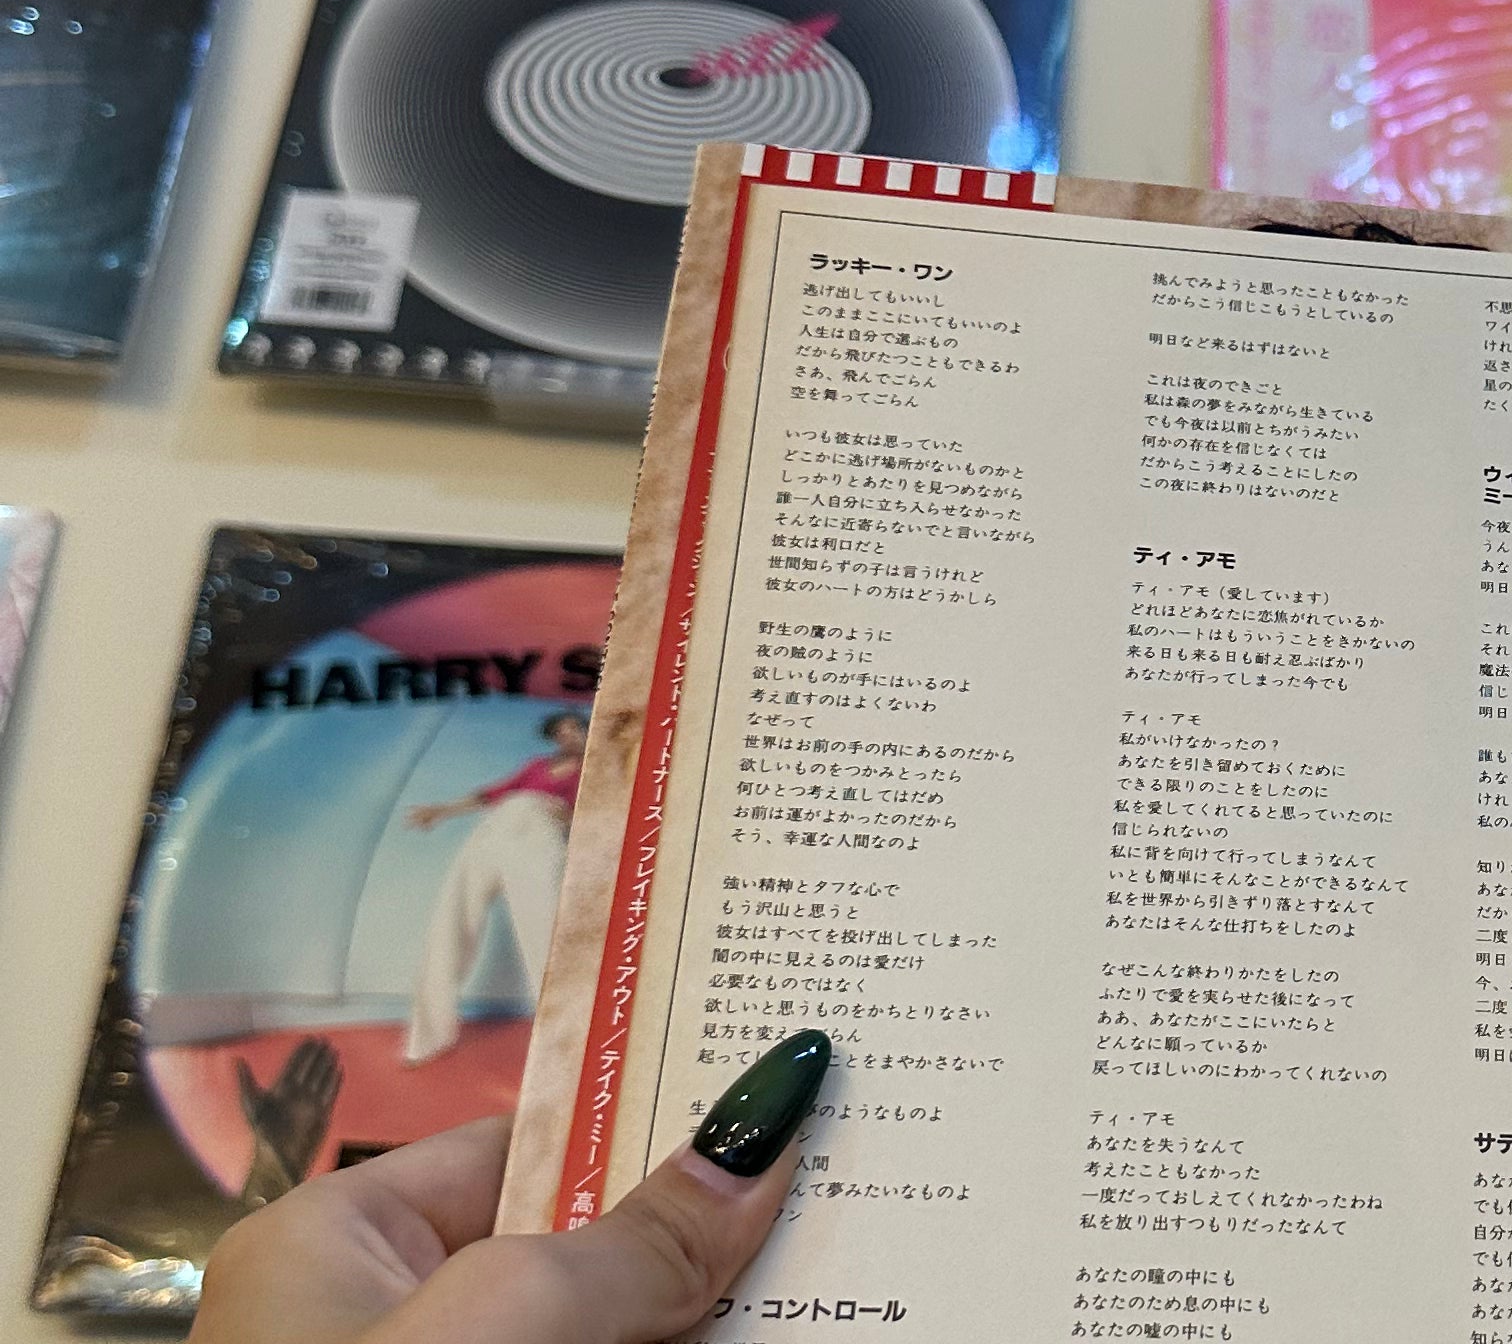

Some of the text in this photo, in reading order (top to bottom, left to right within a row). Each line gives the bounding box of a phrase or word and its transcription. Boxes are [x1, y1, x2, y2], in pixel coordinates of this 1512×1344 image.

[808, 252, 954, 282] ラッキー・ワン
[794, 364, 937, 389] さあ、飛んでごらん
[1146, 372, 1282, 397] これは夜のできごと
[769, 532, 885, 555] 彼女は利口だと
[1132, 545, 1237, 570] ティ・アモ
[250, 648, 545, 714] HARRY
[745, 710, 814, 729] なぜって
[1120, 709, 1202, 727] ティ・アモ
[1110, 820, 1229, 839] 信じられないの
[721, 898, 859, 920] もう沢山と思うと
[701, 1023, 863, 1044] 見方を変えらん
[1088, 1109, 1175, 1127] ティ・アモ
[1085, 1134, 1245, 1155] あなたを失うなんて
